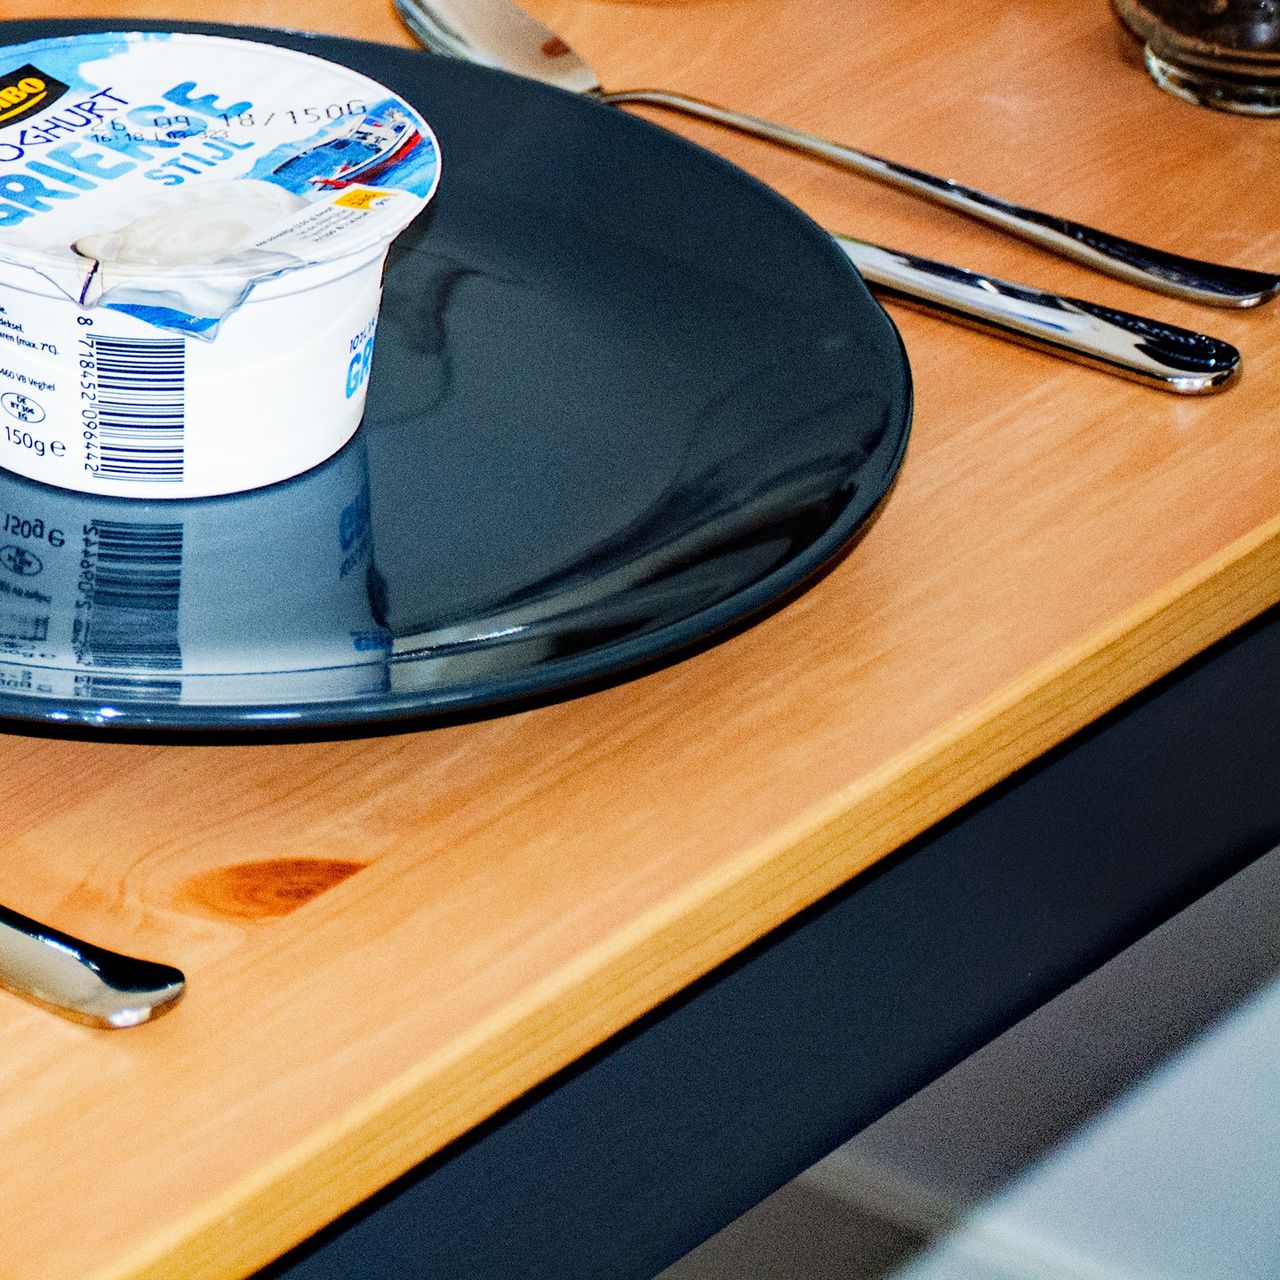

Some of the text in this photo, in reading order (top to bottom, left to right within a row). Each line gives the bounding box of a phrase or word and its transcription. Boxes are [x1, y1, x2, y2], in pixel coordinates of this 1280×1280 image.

[153, 114, 190, 129] 09
[143, 137, 255, 185] STIJL
[0, 319, 24, 333] deksel.
[77, 316, 93, 326] 8
[78, 339, 97, 401] 718452
[28, 376, 56, 392] Veghel
[5, 426, 46, 457] 150g
[81, 409, 99, 472] 096442
